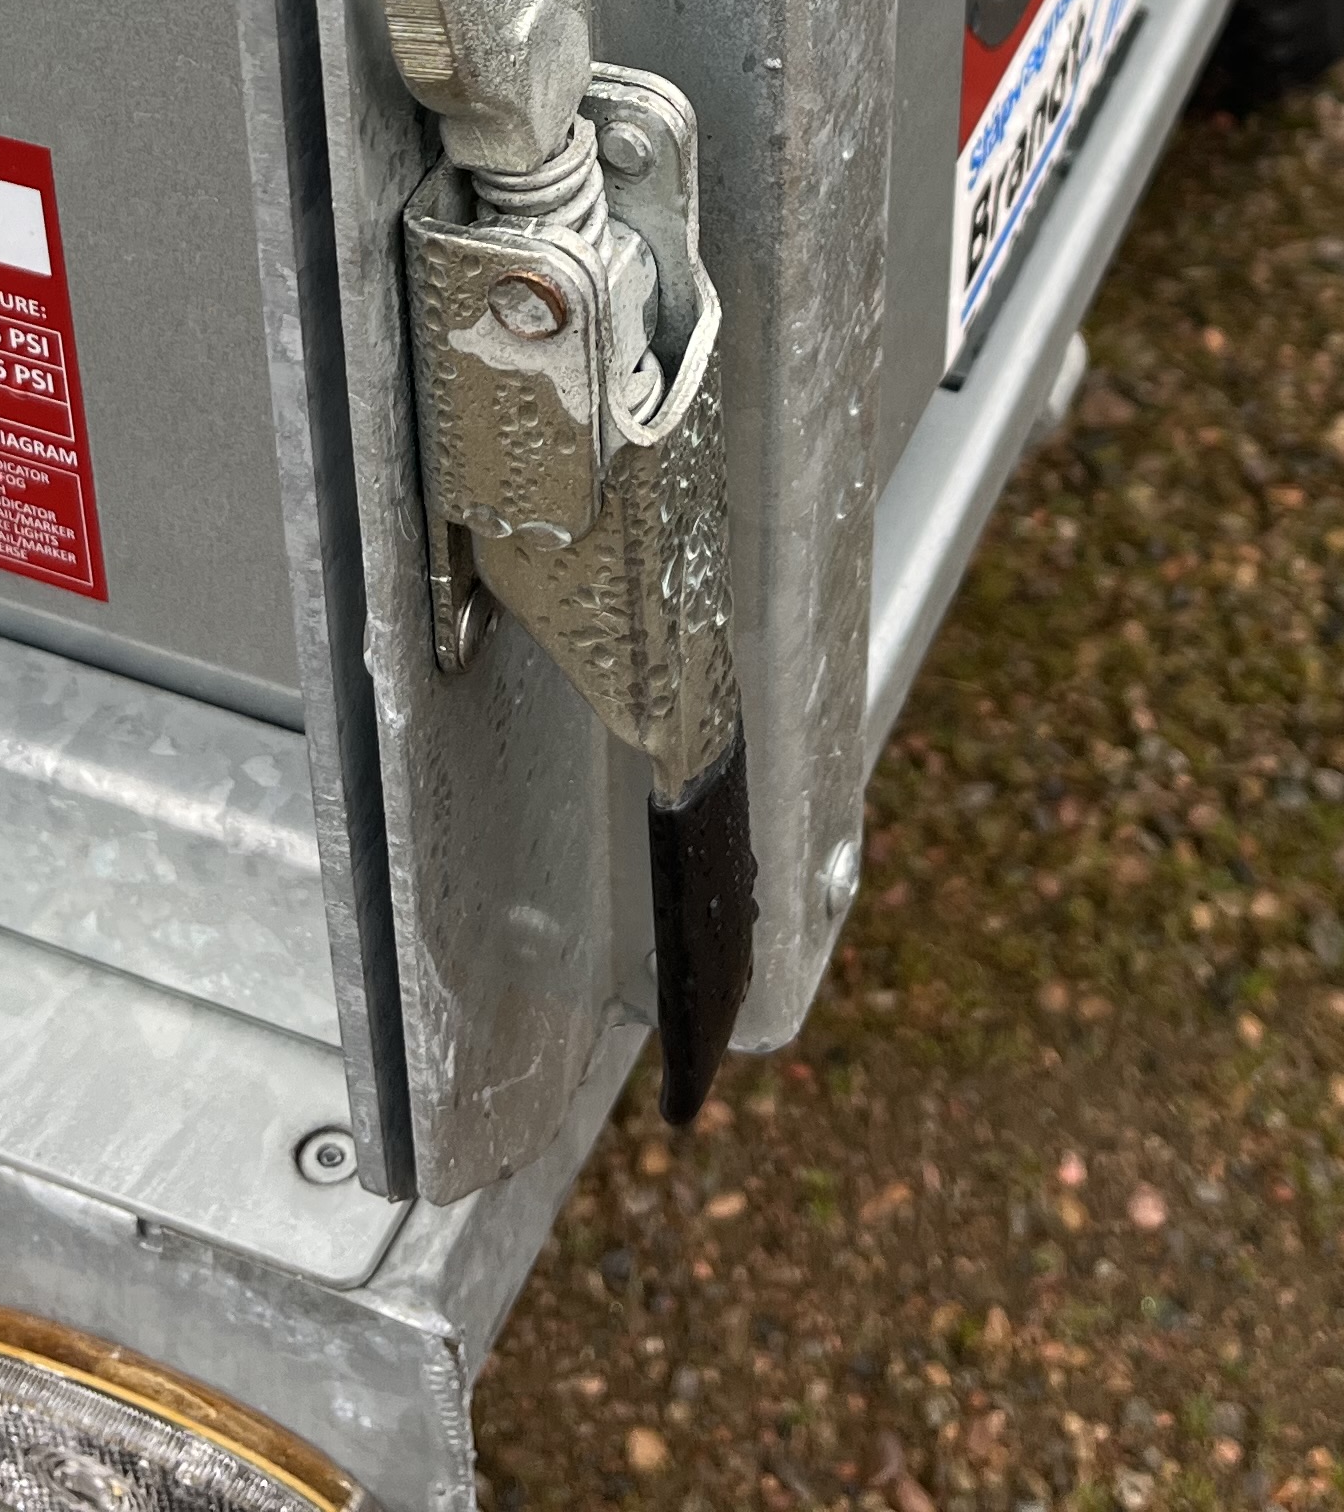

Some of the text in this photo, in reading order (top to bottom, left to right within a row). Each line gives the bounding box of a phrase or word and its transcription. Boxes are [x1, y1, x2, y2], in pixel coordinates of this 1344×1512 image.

[964, 2, 1093, 292] Brandt
[9, 327, 50, 358] PSI
[14, 363, 55, 393] PSI
[14, 523, 59, 547] LIGHTS
